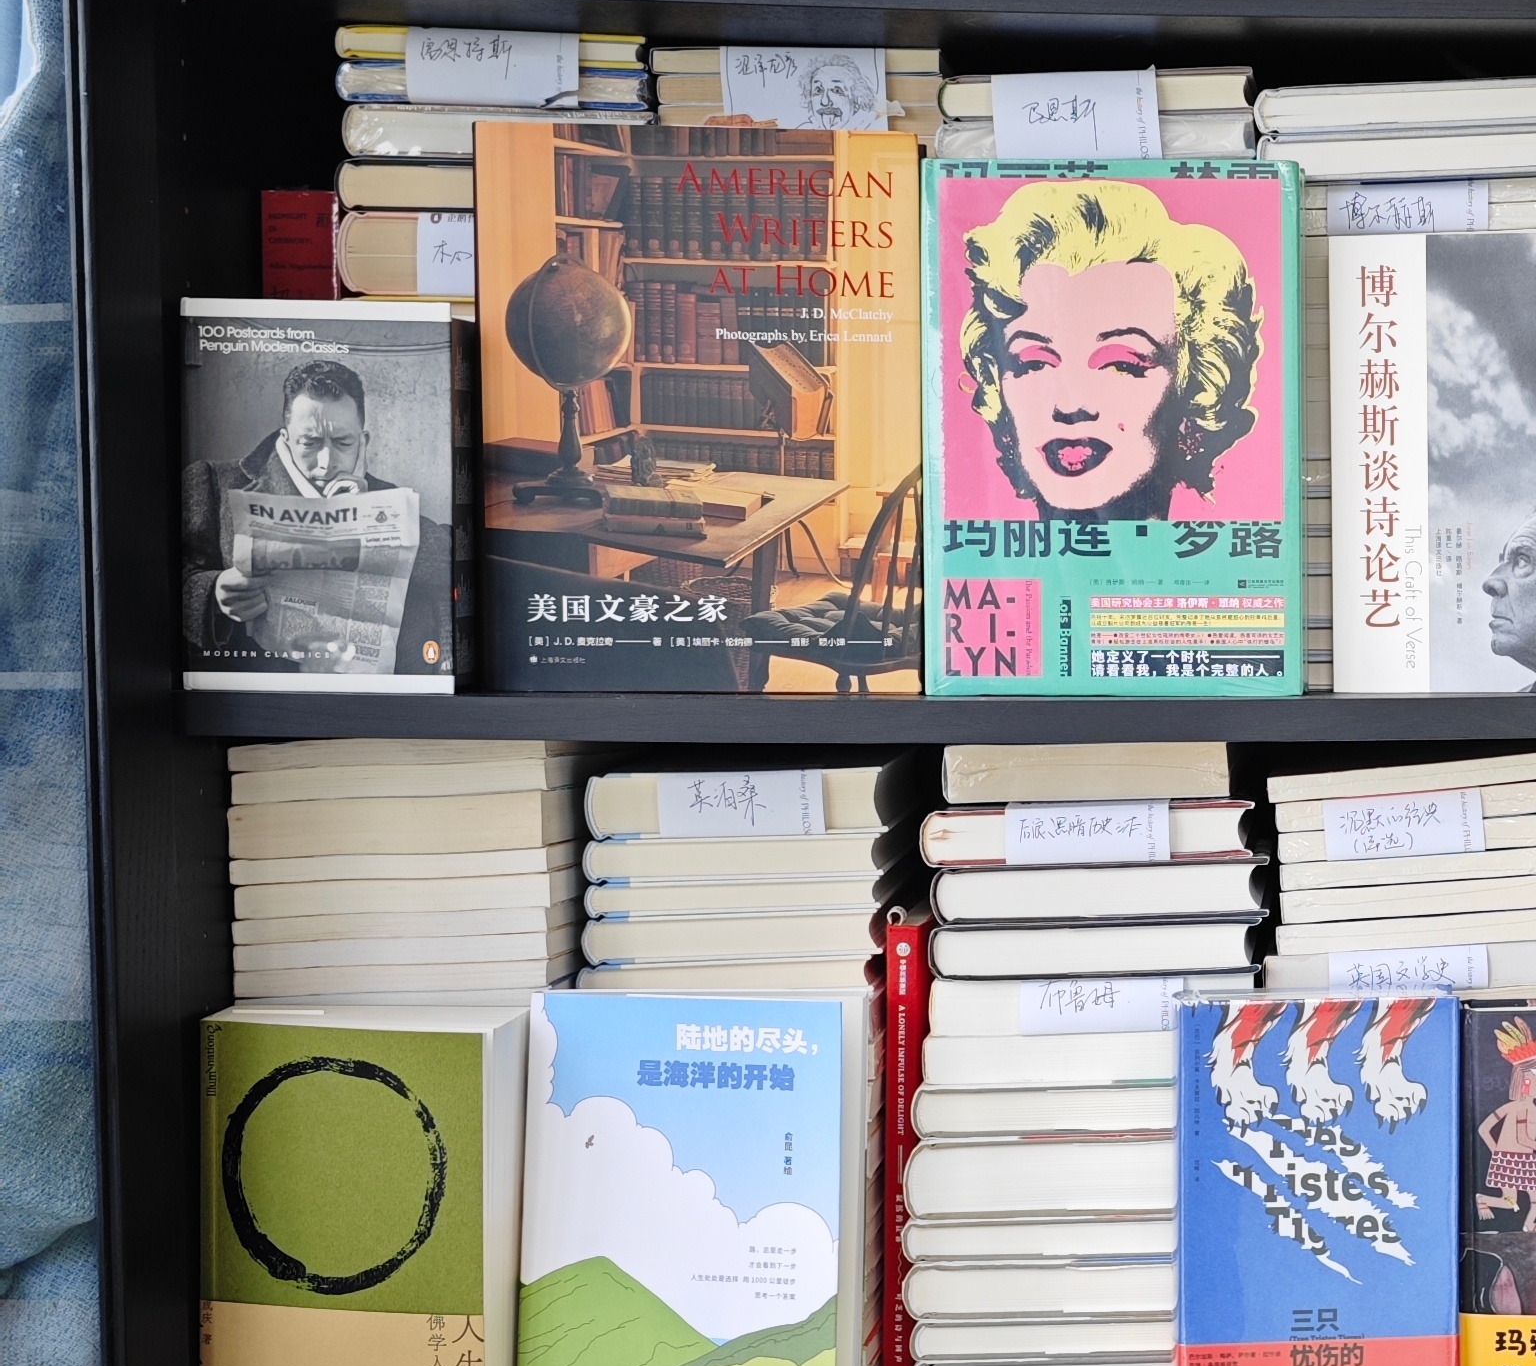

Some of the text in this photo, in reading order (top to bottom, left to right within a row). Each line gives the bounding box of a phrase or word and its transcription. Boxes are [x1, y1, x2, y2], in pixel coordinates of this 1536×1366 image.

[676, 159, 894, 200] AMERICAN
[1339, 193, 1437, 233] 博尔赫斯
[717, 211, 894, 251] WRITERS
[709, 263, 895, 299] AT HOME
[199, 326, 315, 342] 100 Postcards from
[199, 340, 350, 356] Penguin Modern Classics
[1355, 264, 1401, 630] 博尔赫斯谈诗论艺
[249, 503, 358, 526] EN AVANT!
[942, 519, 1284, 561] 玛丽莲·梦露
[527, 593, 729, 624] 美国文豪之家
[203, 649, 331, 659] MODERN CLASSICS
[944, 647, 1018, 677] LYN
[1091, 663, 1285, 677] 请看看我，我是个完整的人。
[676, 1023, 823, 1056] 陆地的尽头，
[637, 1060, 796, 1093] 是海洋的开始
[1289, 1306, 1340, 1333] 三只
